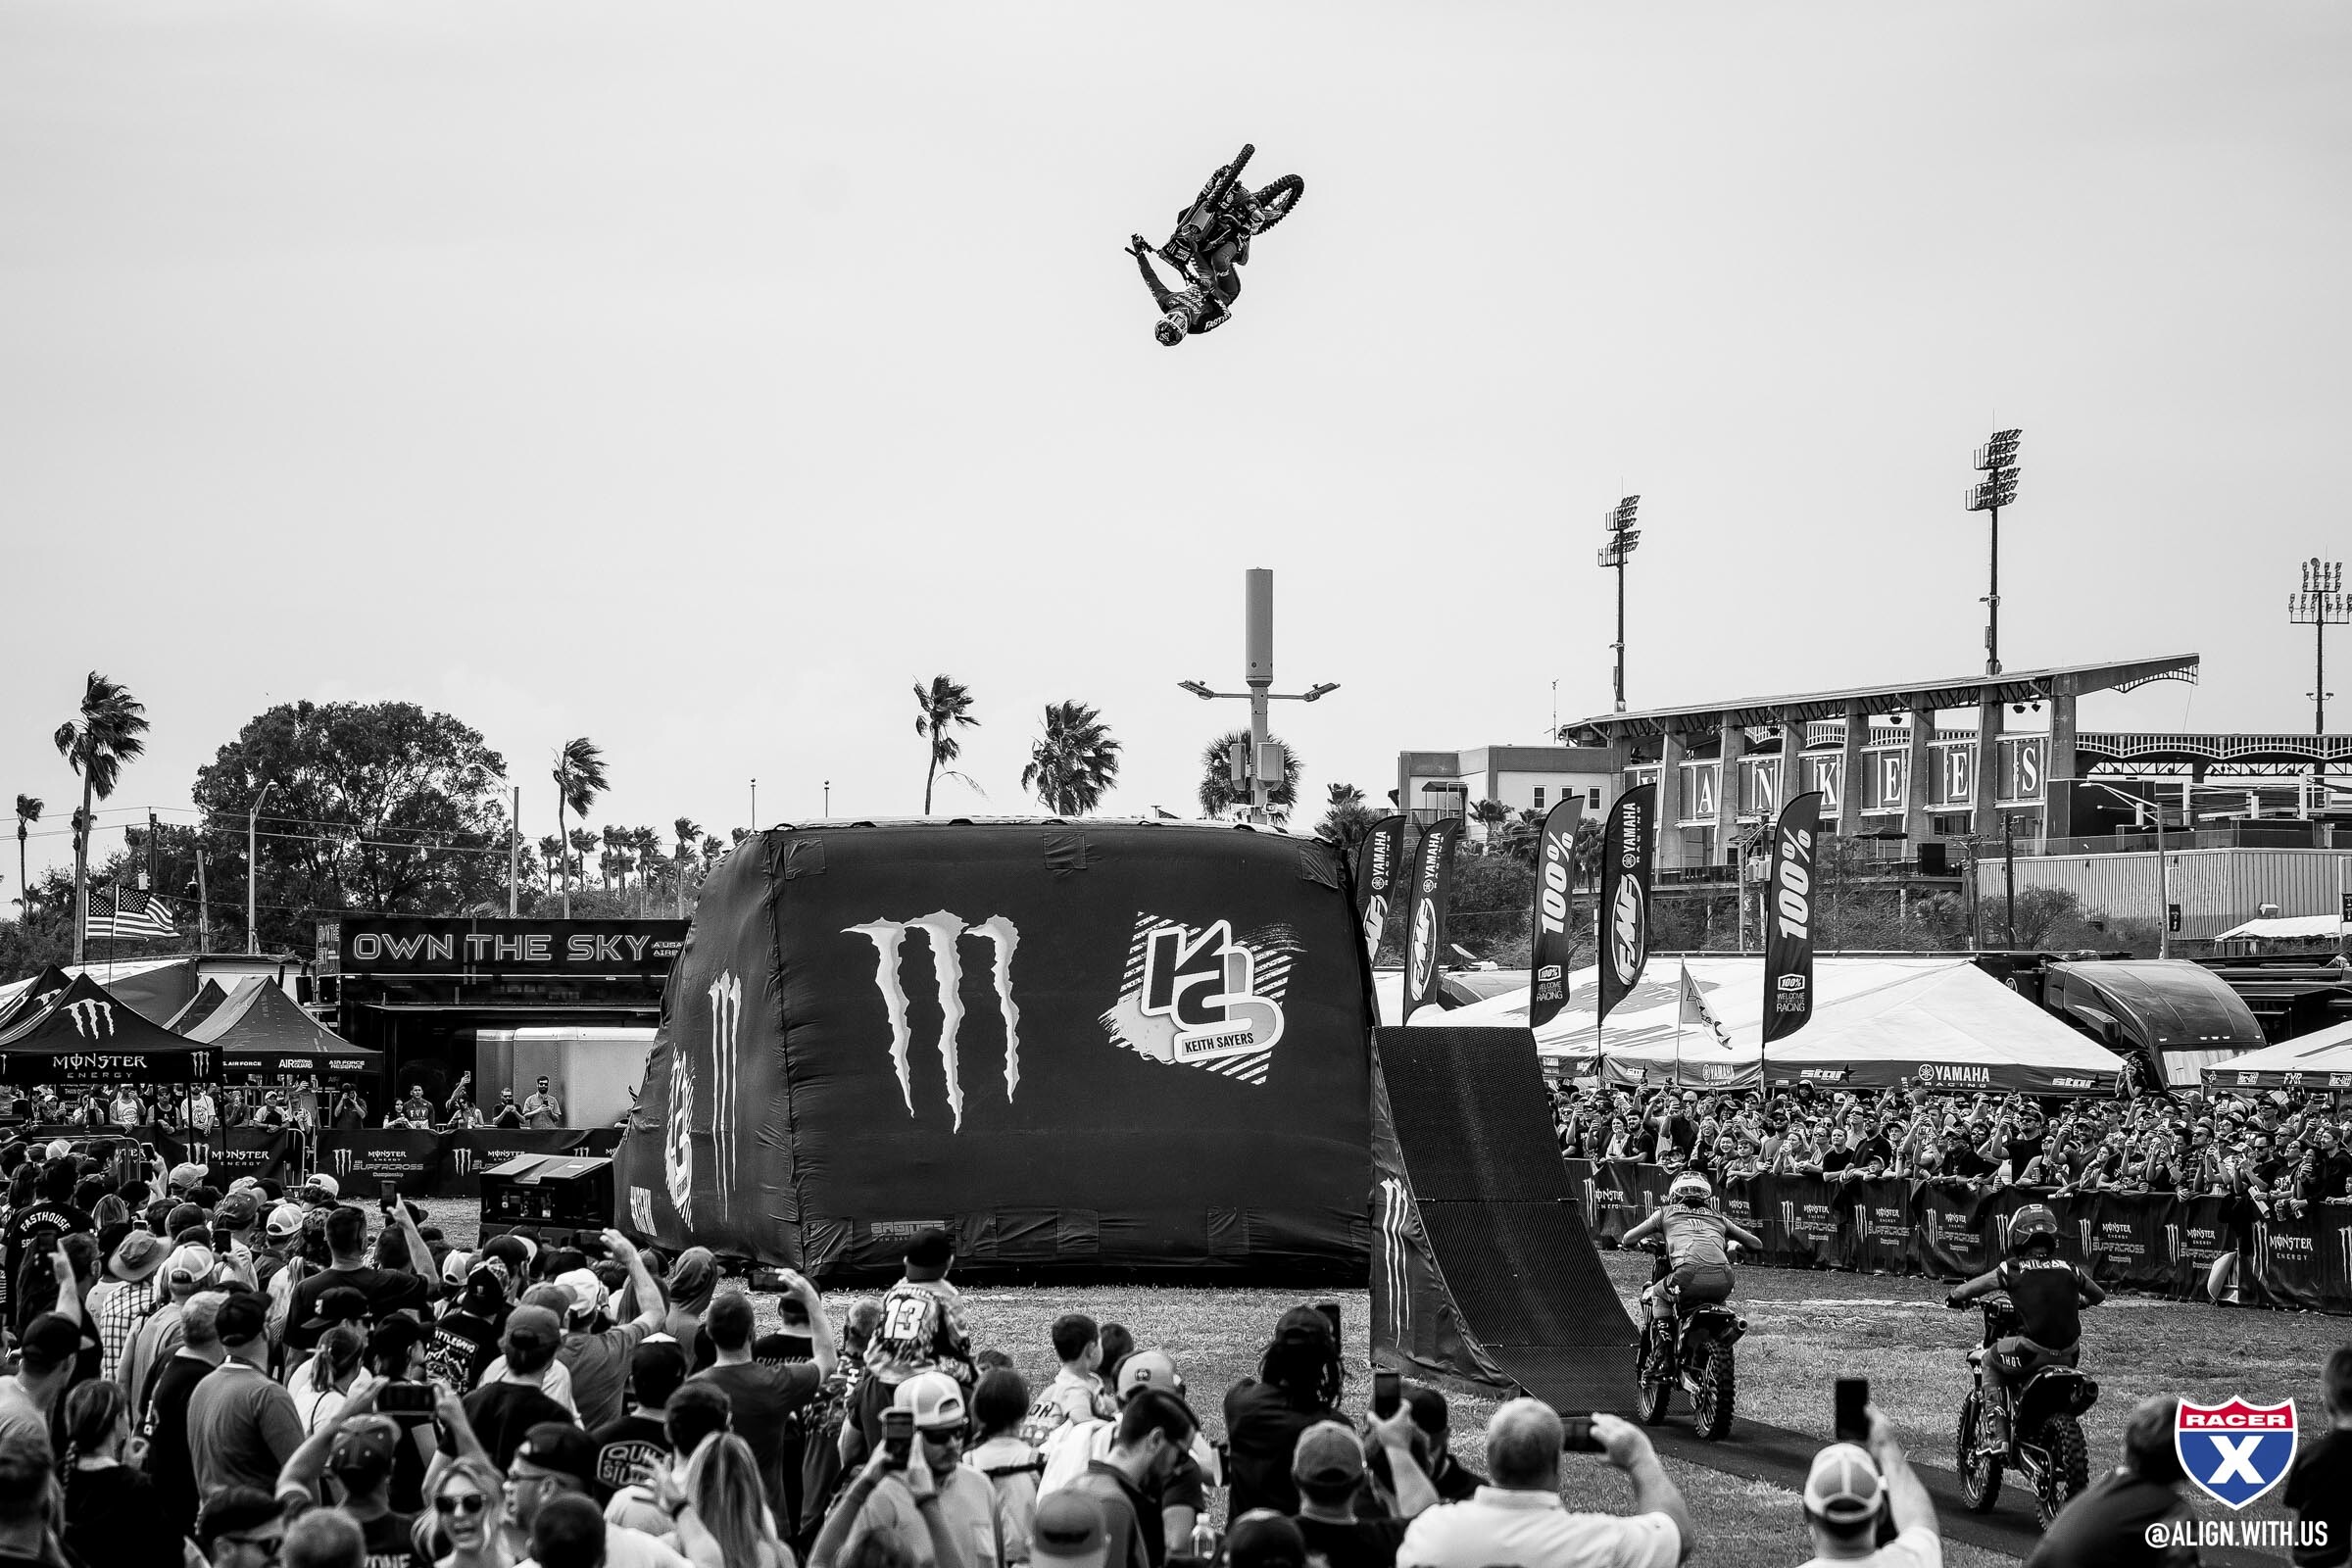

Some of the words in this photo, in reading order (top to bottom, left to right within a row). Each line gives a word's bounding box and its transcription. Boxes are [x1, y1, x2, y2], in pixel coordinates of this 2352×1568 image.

[1641, 746, 2038, 813] ANKEES
[1623, 803, 1637, 853] YAMAHA
[1375, 831, 1387, 876] YAMAHA
[1425, 832, 1442, 878] YAMAHA
[1542, 831, 1574, 934] 100%
[1779, 826, 1811, 940] 100%
[1616, 874, 1638, 984] FMF
[353, 933, 453, 960] OWN
[466, 933, 552, 960] THE
[567, 934, 651, 961] SKY
[1413, 898, 1430, 1001] FMF
[1542, 967, 1558, 978] 100%
[1782, 977, 1802, 988] 100%
[1776, 1003, 1805, 1012] RACING
[1184, 1037, 1214, 1054] KEITH
[1217, 1032, 1254, 1049] SAYERS
[53, 1053, 147, 1070] MONSTER
[278, 1058, 295, 1069] AIR
[1935, 1065, 1990, 1082] YAMAHA
[2283, 1072, 2303, 1084] FXR
[368, 1150, 407, 1158] MONSTER
[20, 1211, 72, 1232] FASTHOUSE
[2102, 1222, 2132, 1234] MONSTER
[2186, 1228, 2216, 1240] MONSTER
[2270, 1234, 2314, 1250] MONSTER
[2277, 1252, 2308, 1261] ENERGY
[884, 1298, 928, 1341] 13
